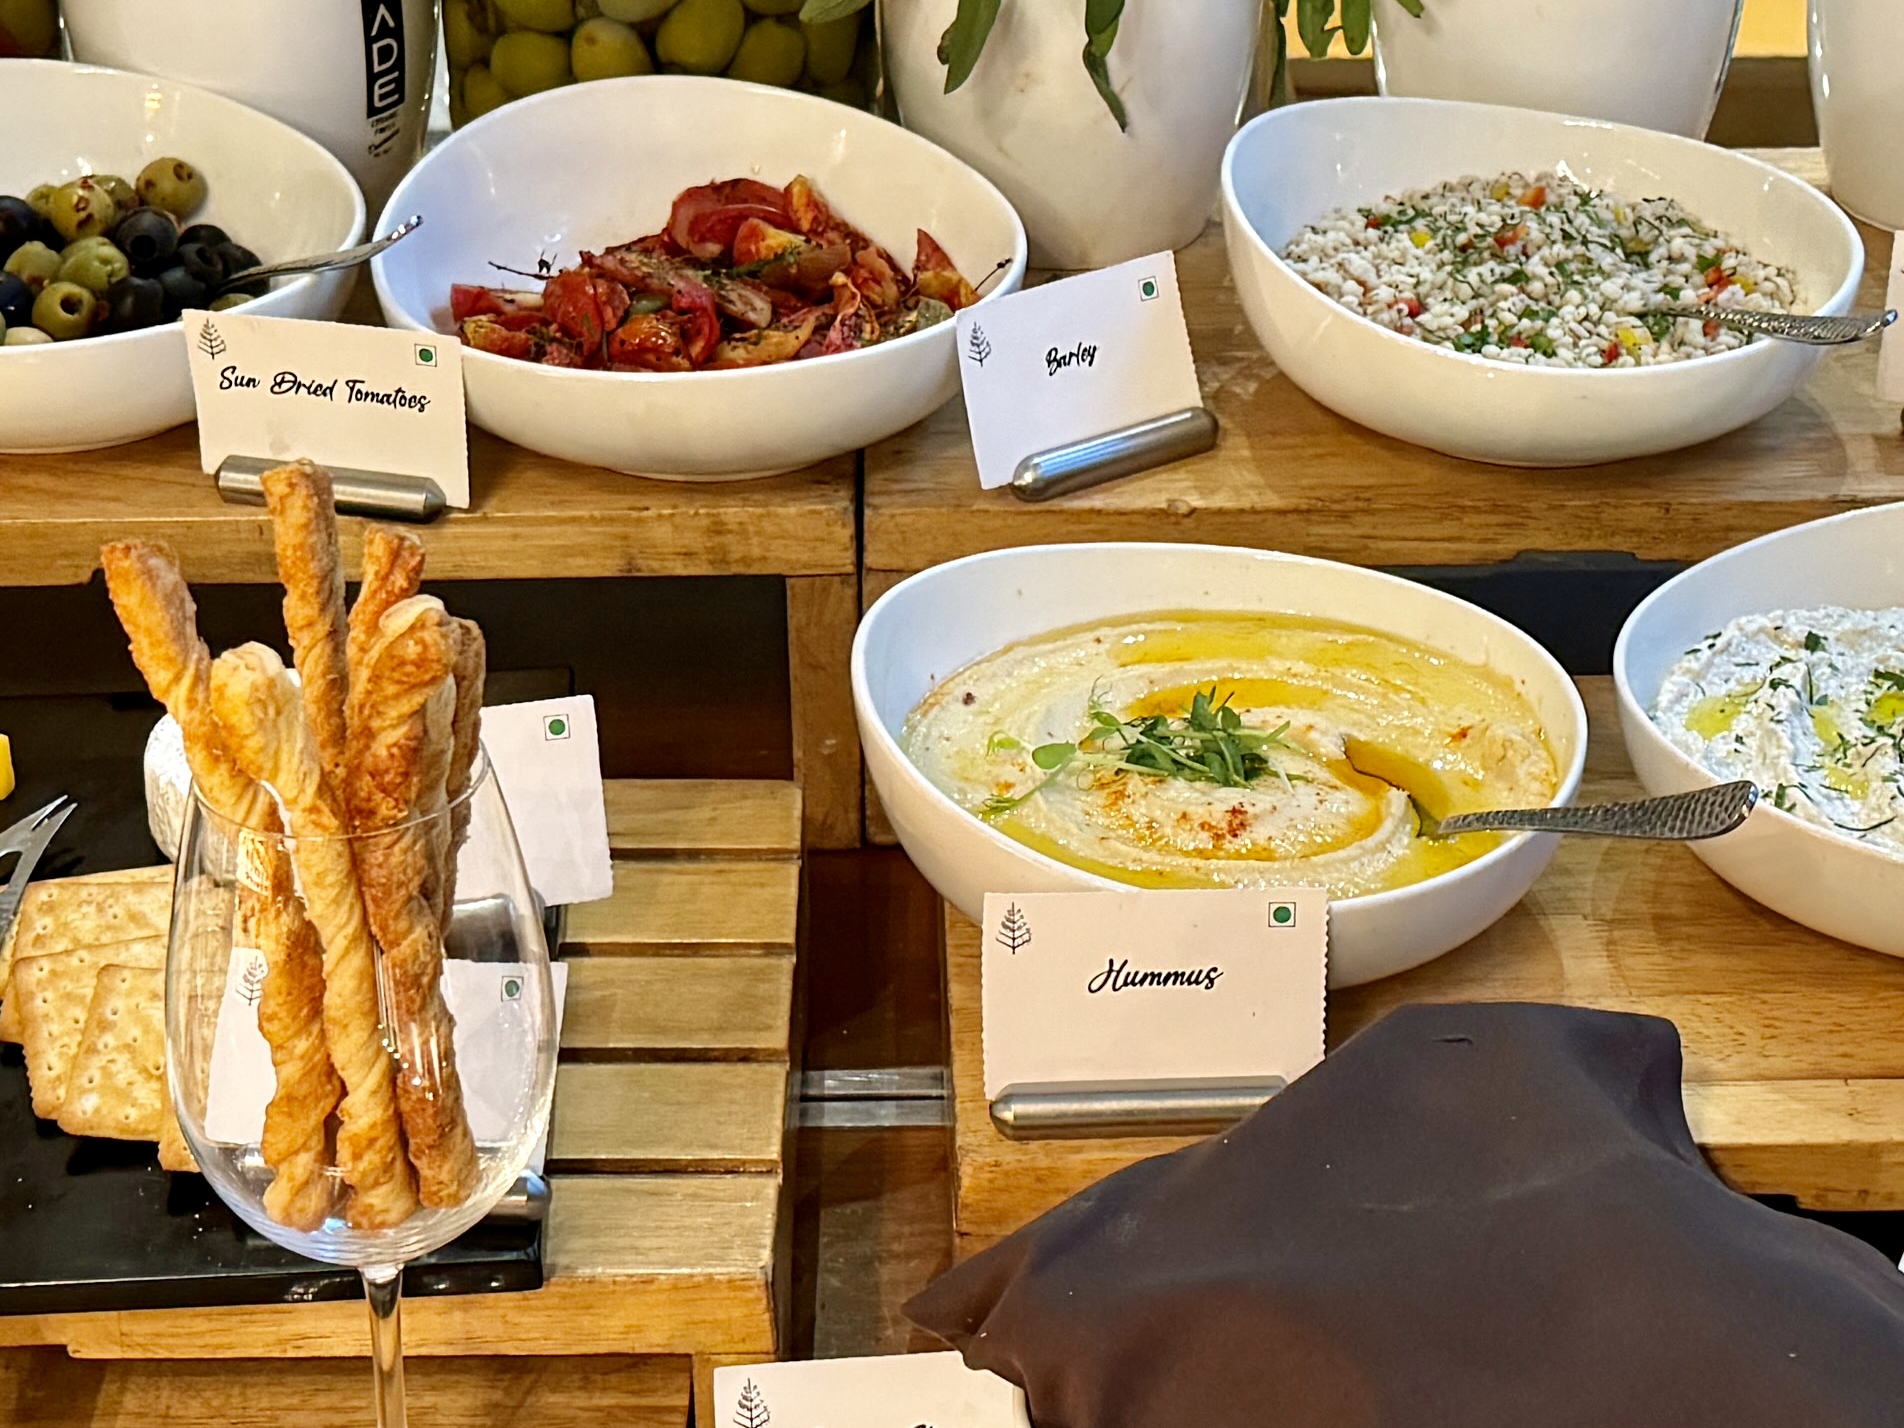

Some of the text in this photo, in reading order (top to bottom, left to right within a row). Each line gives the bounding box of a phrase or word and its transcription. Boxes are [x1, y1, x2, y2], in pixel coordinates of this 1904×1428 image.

[1045, 341, 1098, 377] Barley
[218, 365, 432, 413] Sun Dried Tomatoes
[1087, 957, 1225, 994] Hummus
